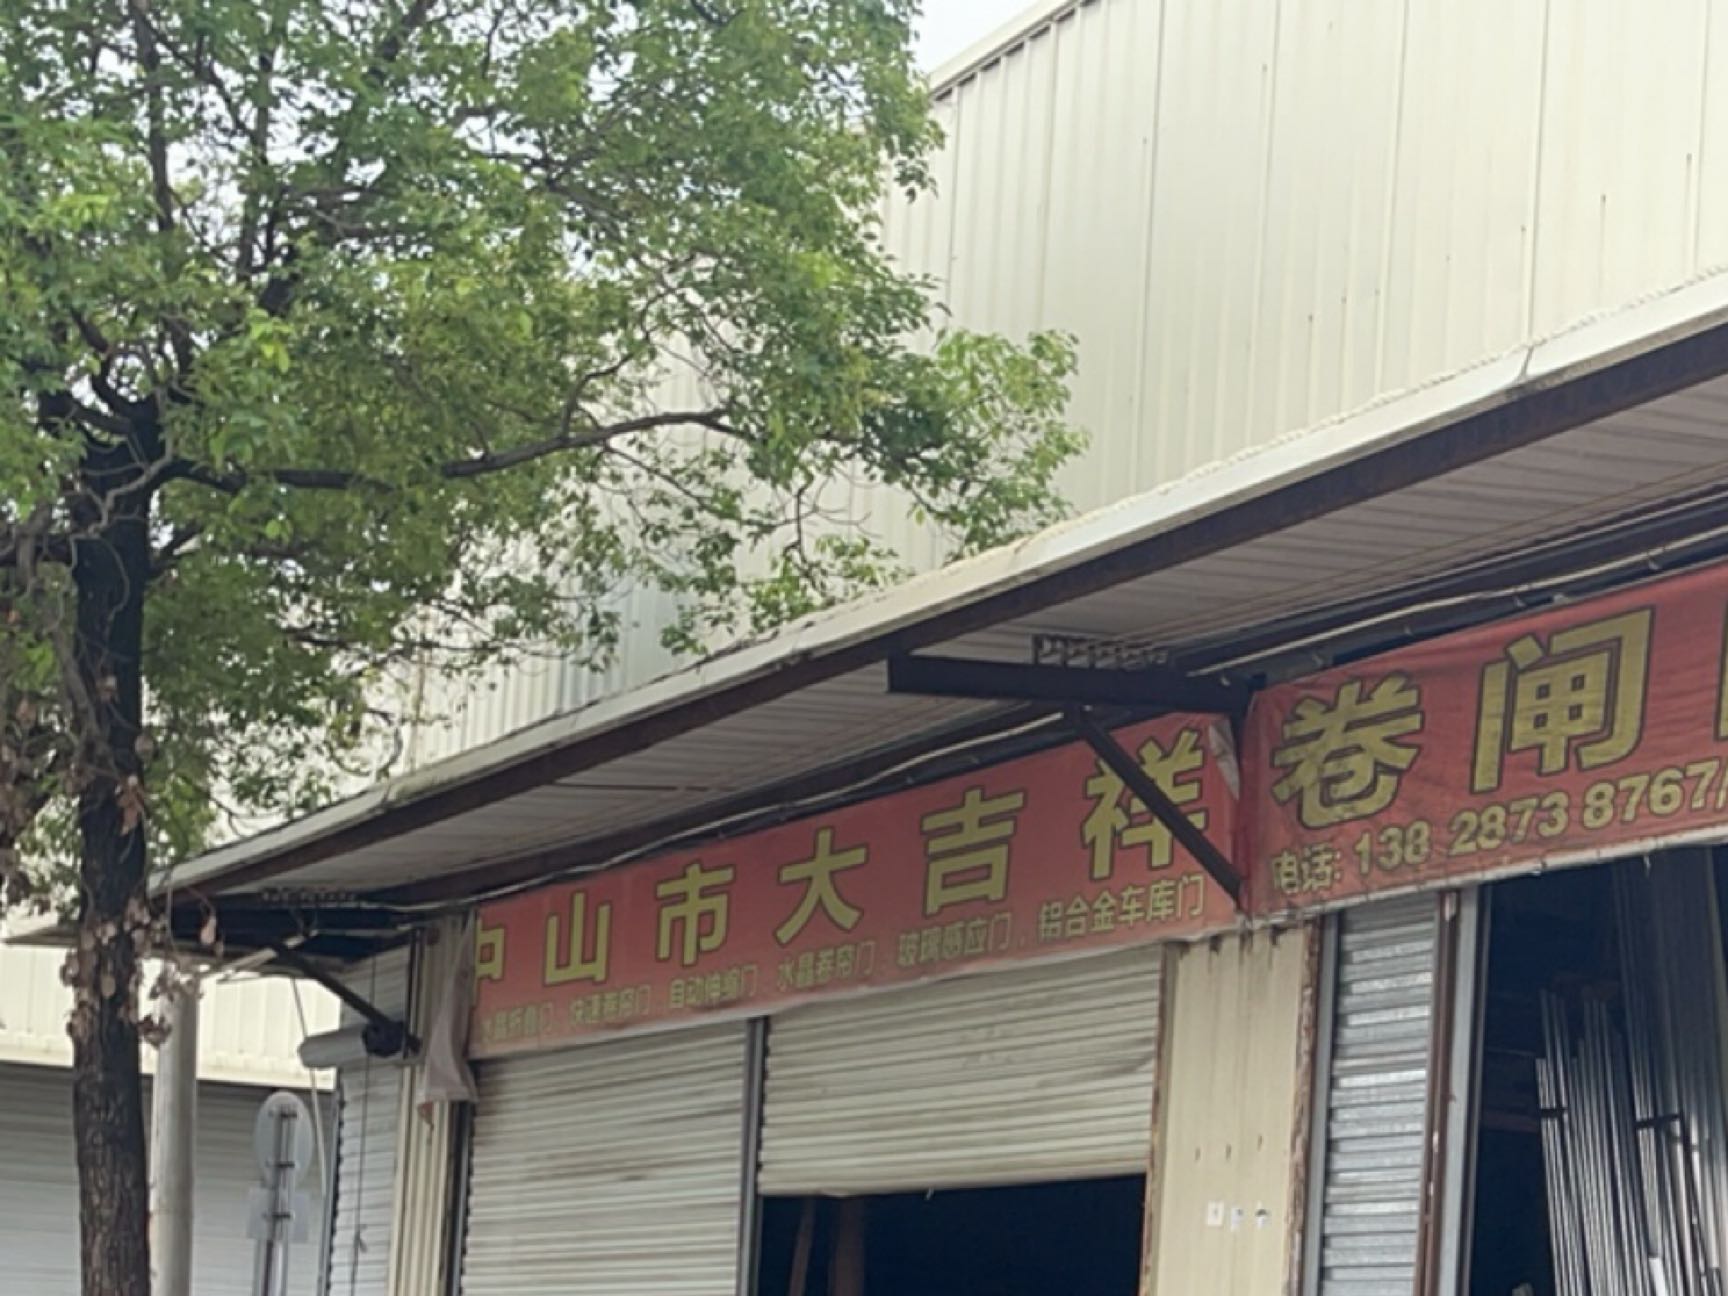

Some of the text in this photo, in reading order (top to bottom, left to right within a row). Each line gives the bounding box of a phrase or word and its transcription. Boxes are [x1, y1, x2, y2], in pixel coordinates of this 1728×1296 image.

[474, 728, 1208, 1005] 中山市大吉祥
[1353, 819, 1431, 875] 138
[1448, 792, 1570, 857] 2873
[1037, 872, 1206, 941] 铝合金车库门
